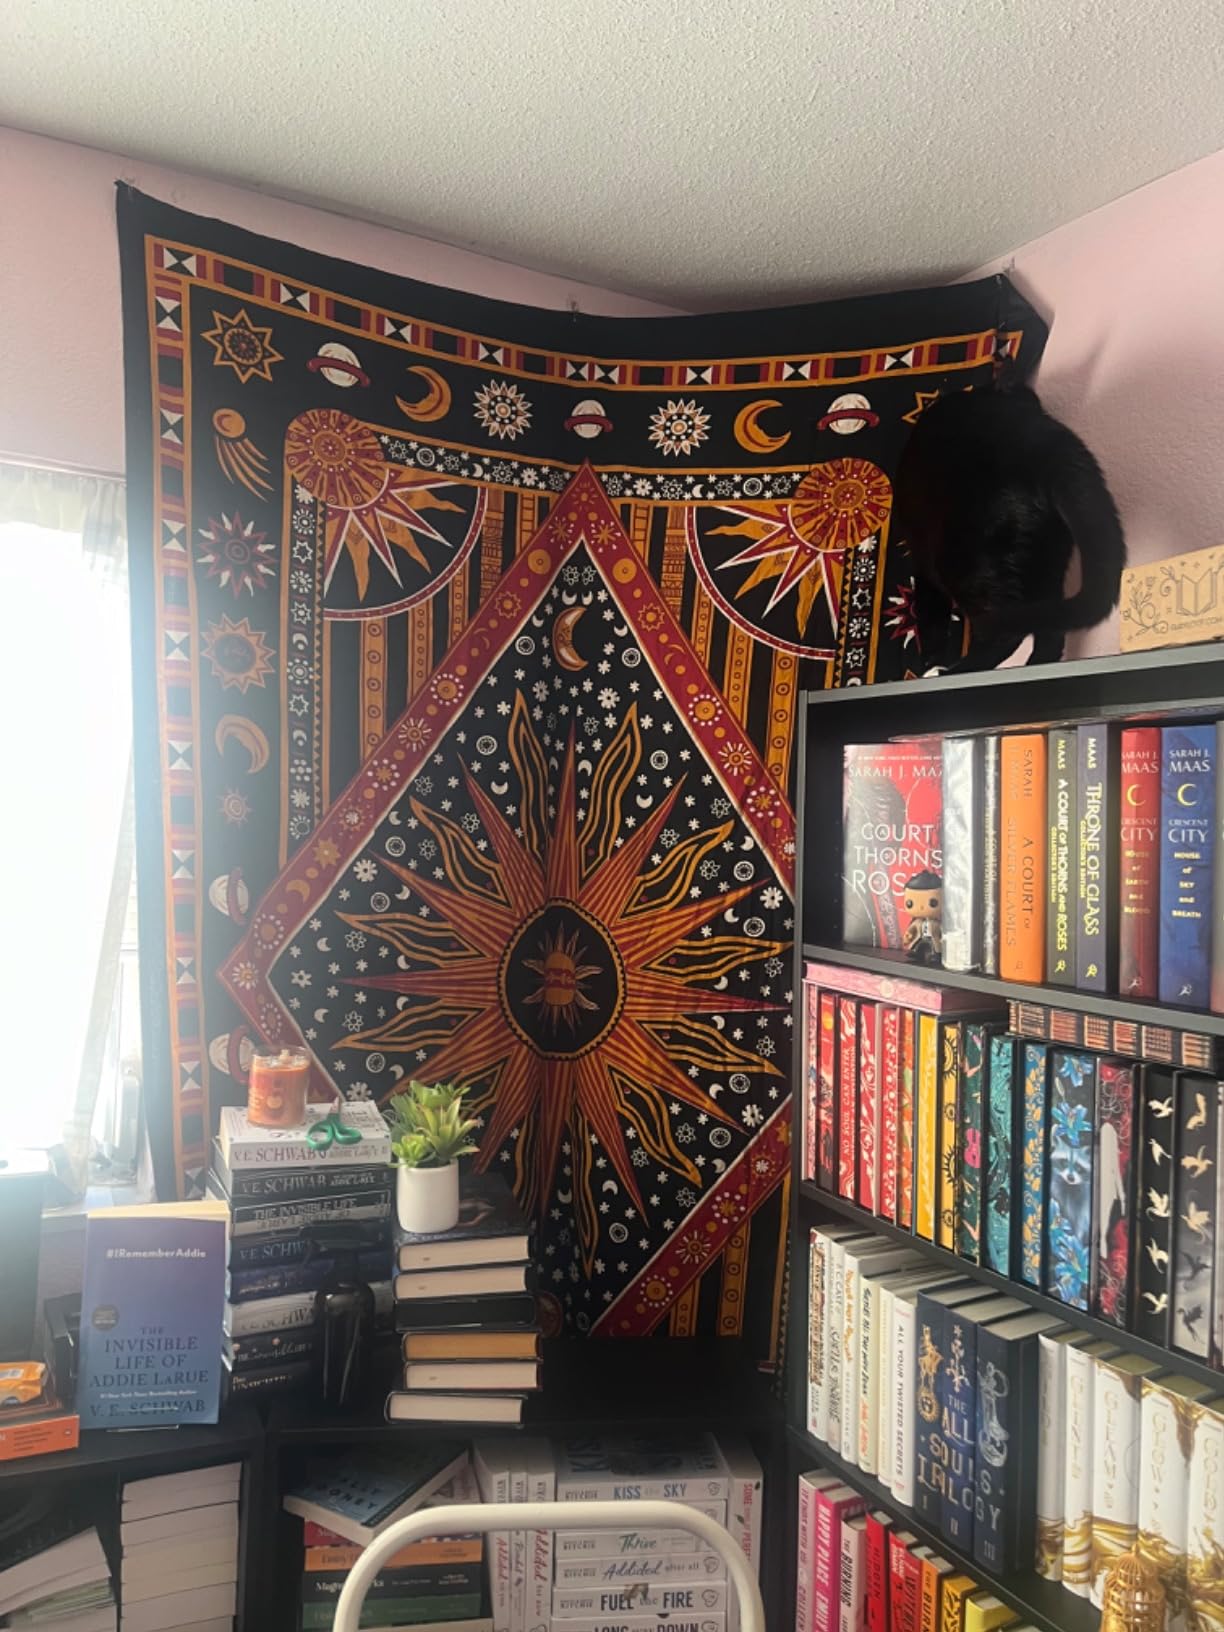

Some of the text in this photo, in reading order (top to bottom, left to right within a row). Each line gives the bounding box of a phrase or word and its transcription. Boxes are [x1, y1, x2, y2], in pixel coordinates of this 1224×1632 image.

[1057, 739, 1066, 769] MAAS
[1121, 750, 1150, 760] SARAH
[1168, 749, 1201, 759] SARAH
[849, 765, 892, 778] SARAH
[912, 765, 943, 778] MA
[1023, 749, 1033, 798] SARAH
[1121, 761, 1159, 774] MAAS
[1167, 759, 1211, 775] MAAS
[1058, 778, 1068, 789] A
[1057, 791, 1069, 832] COURT
[861, 822, 934, 841] COURT
[1168, 818, 1209, 827] CRESCENT
[1022, 836, 1034, 849] A
[1084, 737, 1103, 936] MAAS THRONE OF GLASS
[1121, 827, 1158, 842] CITY
[1167, 828, 1209, 843] CITY
[854, 845, 943, 868] THORNS
[1173, 851, 1201, 859] HOUSE
[1057, 844, 1068, 894] THORNS
[853, 869, 908, 897] ROS
[1022, 855, 1034, 915] COURT
[1178, 880, 1195, 889] SKY
[1171, 909, 1202, 919] BREATH
[1057, 913, 1068, 951] ROSES
[255, 1146, 316, 1162] SCHWAB
[262, 1240, 305, 1260] SCHW
[141, 1326, 164, 1336] THE
[105, 1336, 199, 1353] INVISIBLE
[115, 1353, 187, 1370] LIFE OF
[897, 1349, 905, 1378] YOUR
[89, 1372, 147, 1388] ADDIE
[130, 1400, 206, 1416] SCHWAB
[896, 1381, 904, 1427] TWISTED
[948, 1394, 967, 1415] THE
[942, 1407, 975, 1445] ALL
[895, 1430, 904, 1476] SECRETS
[613, 1485, 641, 1500] KISS
[663, 1482, 687, 1498] SKY
[800, 1499, 809, 1523] ENDS
[618, 1532, 657, 1552] Thrive
[800, 1524, 808, 1550] WITH
[800, 1551, 807, 1564] US
[815, 1503, 831, 1630] HAPPY PLACE EMILY
[602, 1559, 663, 1581] Addicted
[688, 1561, 699, 1571] all
[841, 1552, 853, 1608] BURNING
[870, 1548, 881, 1600] HIDDEN
[600, 1593, 634, 1611] FUEL
[663, 1591, 694, 1609] FIRE
